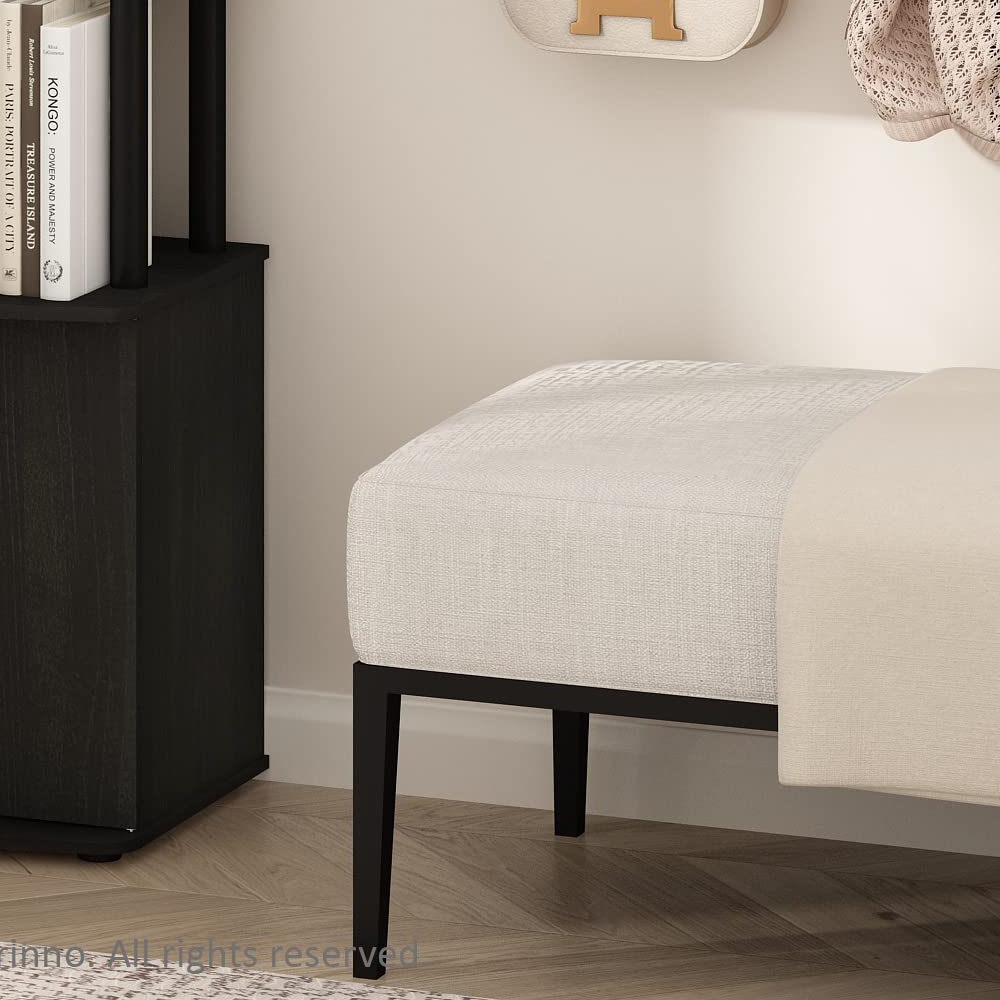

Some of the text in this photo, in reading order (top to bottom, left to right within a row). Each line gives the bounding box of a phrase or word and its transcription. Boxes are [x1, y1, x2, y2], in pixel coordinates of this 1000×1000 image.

[47, 77, 58, 135] KONGO:
[5, 83, 14, 253] PARIS: PORTRAIT OF A CITY
[26, 143, 35, 249] TREASURE ISLAND
[48, 147, 56, 244] POWER AND MAJESTY
